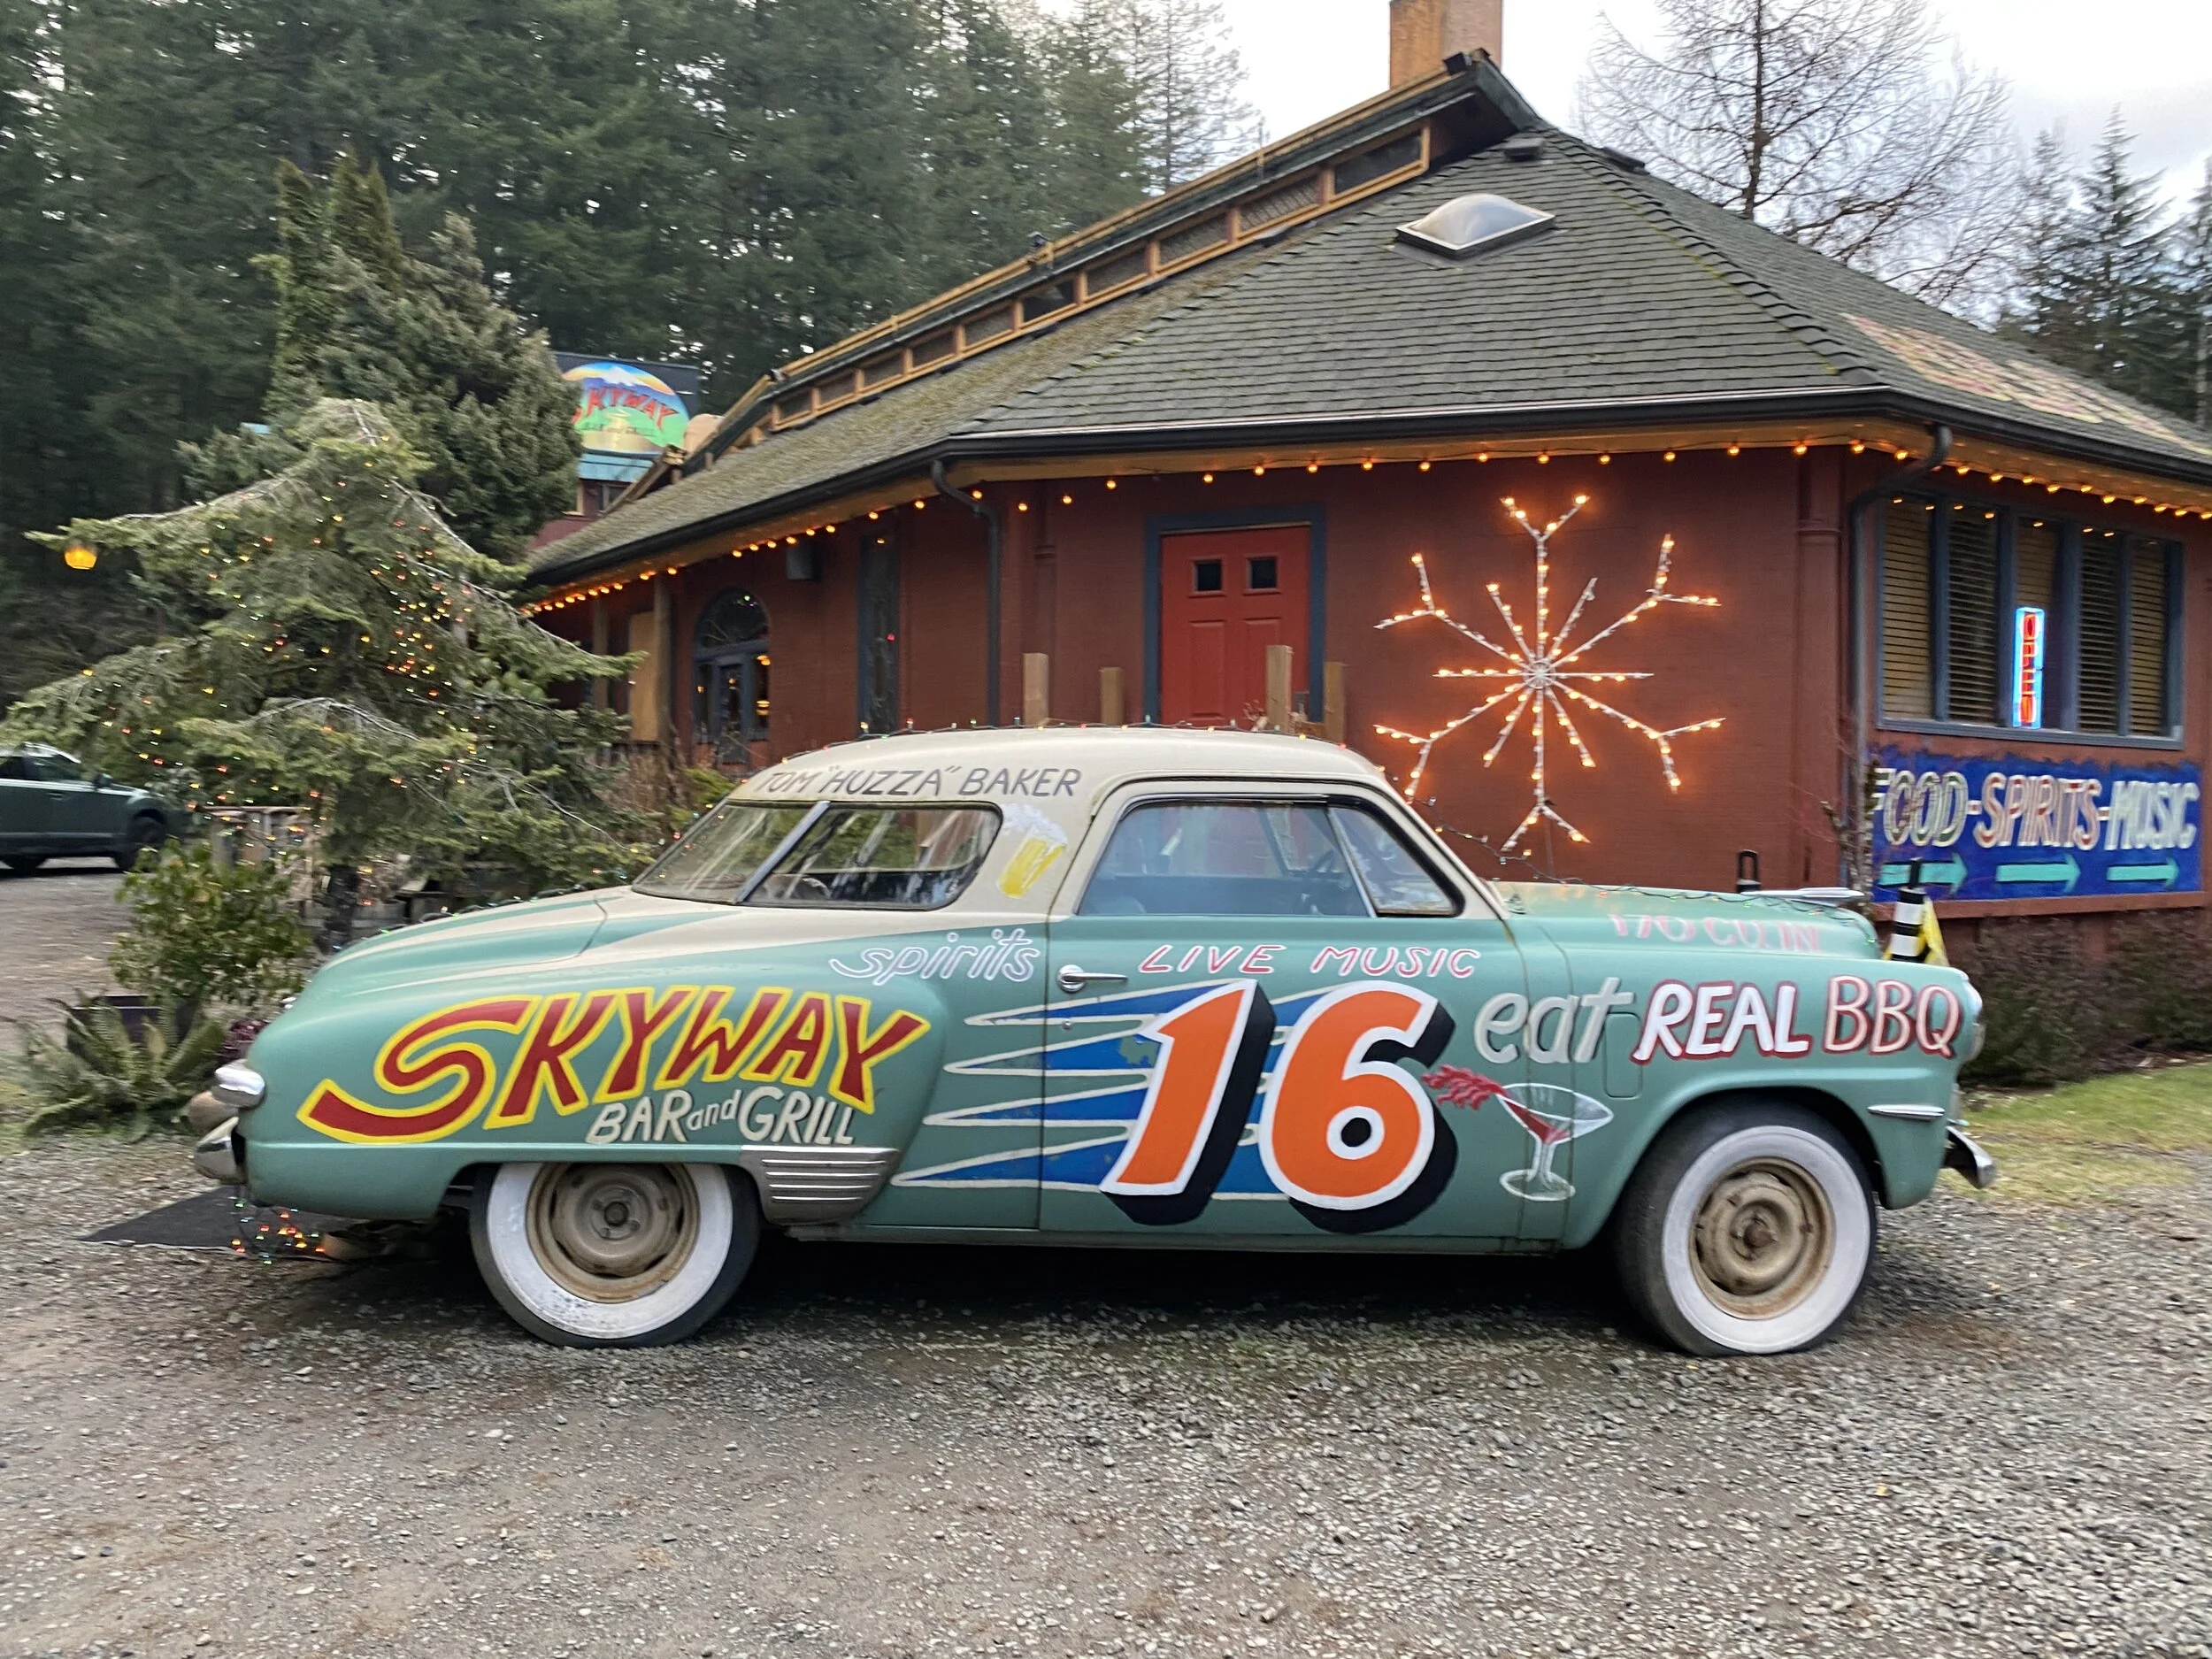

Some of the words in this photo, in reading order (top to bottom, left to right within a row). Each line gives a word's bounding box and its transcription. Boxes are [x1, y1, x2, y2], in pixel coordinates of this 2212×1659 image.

[2018, 612, 2039, 724] OPEN
[757, 771, 816, 794] TOM
[958, 767, 1082, 797] BAKER
[829, 928, 1041, 987] spirits
[1139, 945, 1286, 973] LIVE
[1310, 946, 1481, 979] MUSIC
[1473, 977, 1635, 1064] eat
[1631, 979, 1814, 1065] REAL
[1824, 974, 1963, 1056] BBQ
[296, 986, 932, 1143] SKYWAY
[586, 1089, 693, 1144] BAR
[687, 1089, 741, 1131] and
[737, 1086, 856, 1145] GRILL
[1100, 979, 1458, 1233] 16
